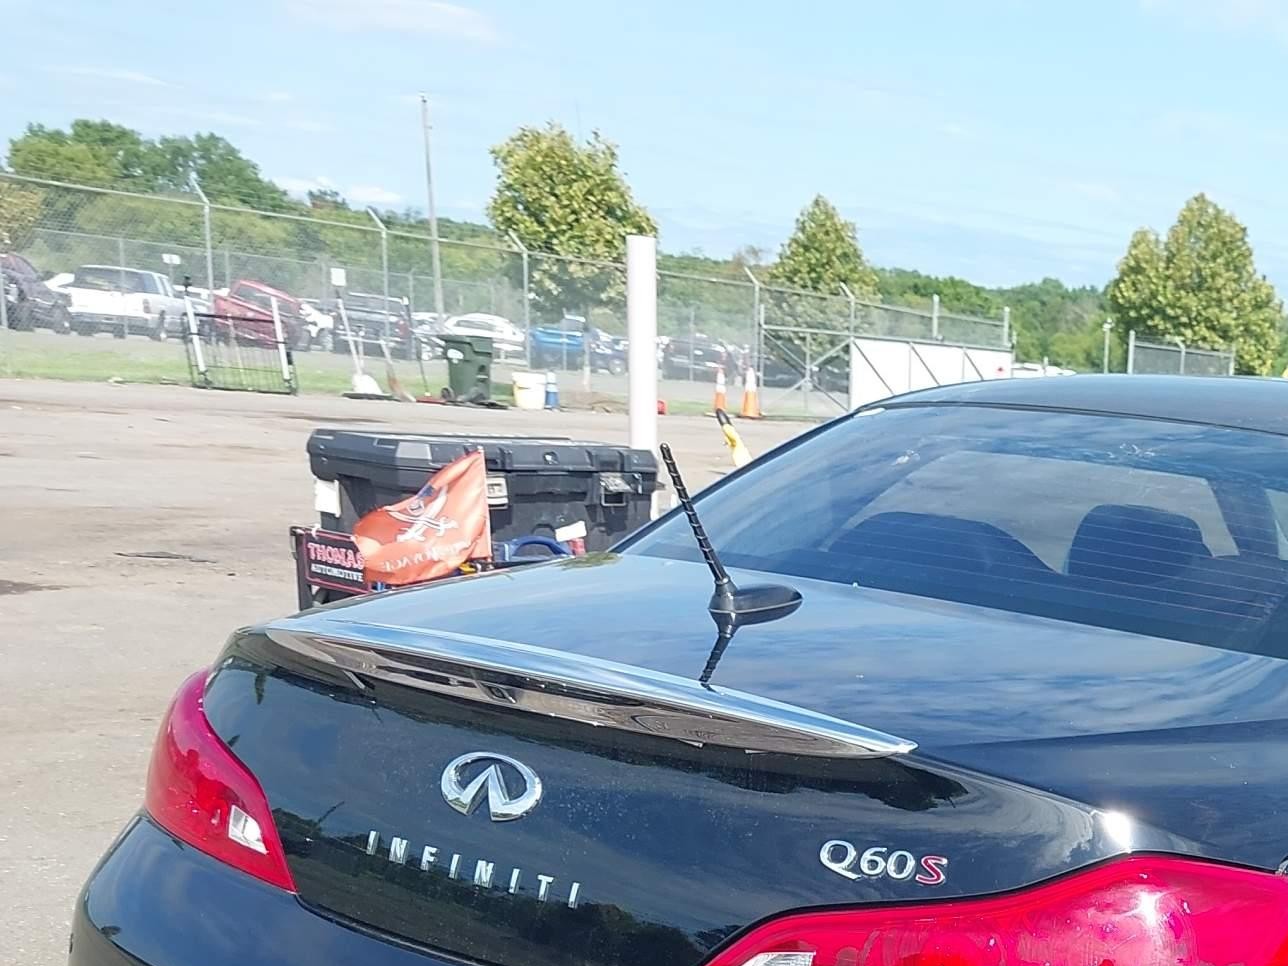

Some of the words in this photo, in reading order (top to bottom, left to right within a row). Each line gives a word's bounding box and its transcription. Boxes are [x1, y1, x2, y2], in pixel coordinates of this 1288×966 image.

[307, 543, 365, 570] THOMAS
[366, 830, 580, 909] INFINITI
[819, 840, 948, 886] Q60S
